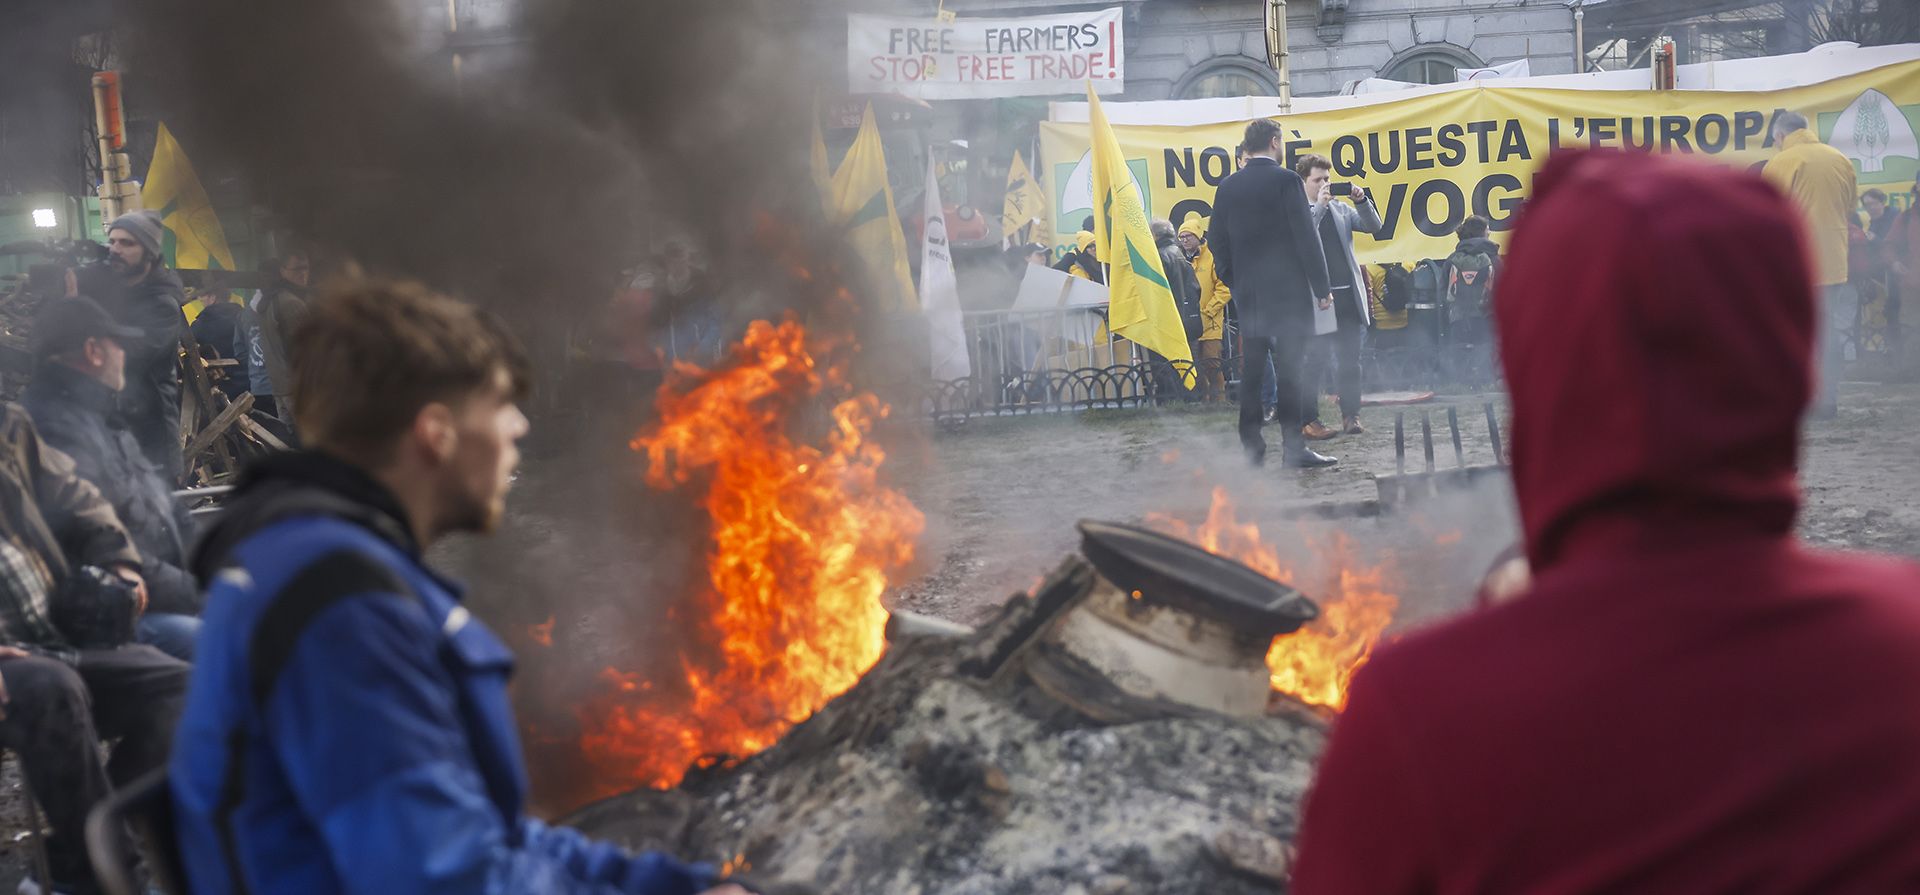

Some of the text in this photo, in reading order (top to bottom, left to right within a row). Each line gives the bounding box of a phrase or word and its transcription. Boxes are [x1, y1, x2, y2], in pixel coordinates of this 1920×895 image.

[889, 23, 1099, 55] FREE FARMERS
[957, 55, 1014, 81] FREE
[1164, 146, 1247, 188] NO
[1331, 118, 1531, 178] QUESTA
